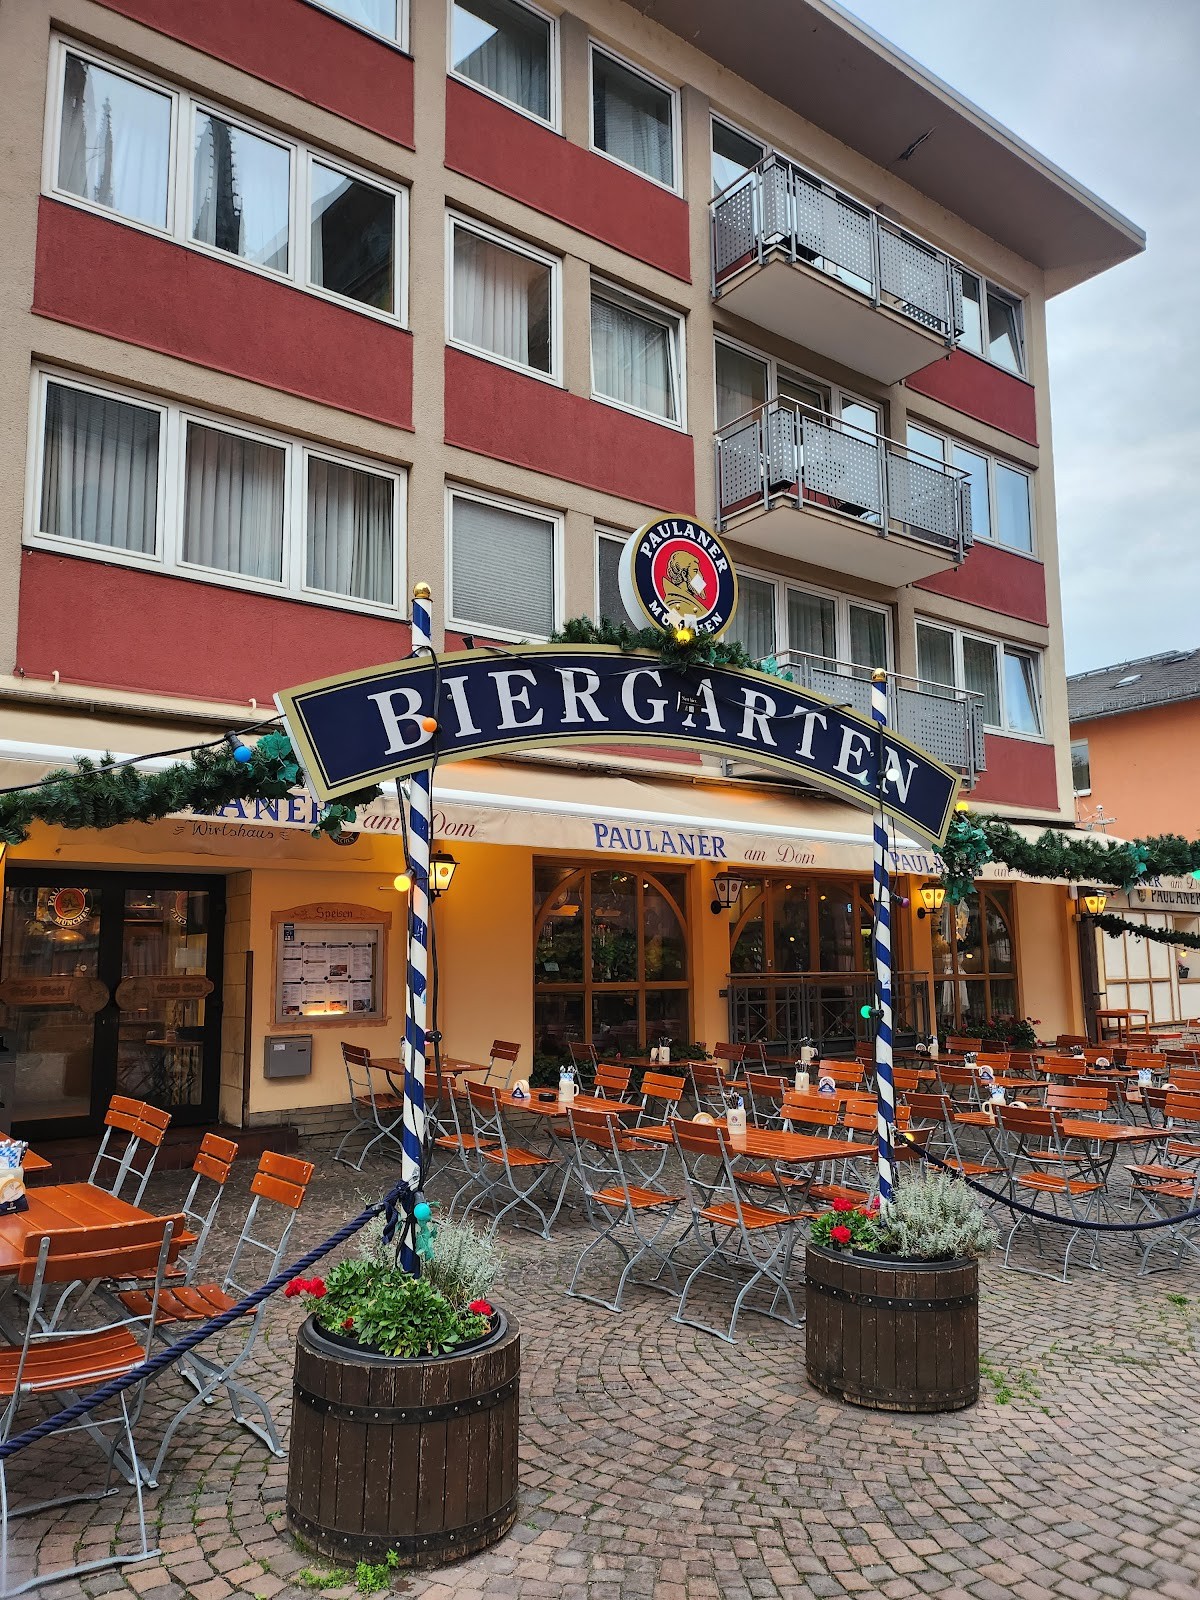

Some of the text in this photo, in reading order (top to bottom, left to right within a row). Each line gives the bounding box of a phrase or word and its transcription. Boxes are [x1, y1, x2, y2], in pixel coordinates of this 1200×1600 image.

[640, 521, 728, 574] PAULANER
[367, 667, 919, 804] BIERGARTEN
[186, 819, 274, 839] Wirtshaus
[363, 815, 400, 830] am
[432, 809, 477, 837] Dom
[593, 822, 816, 865] PAULANER am Dom
